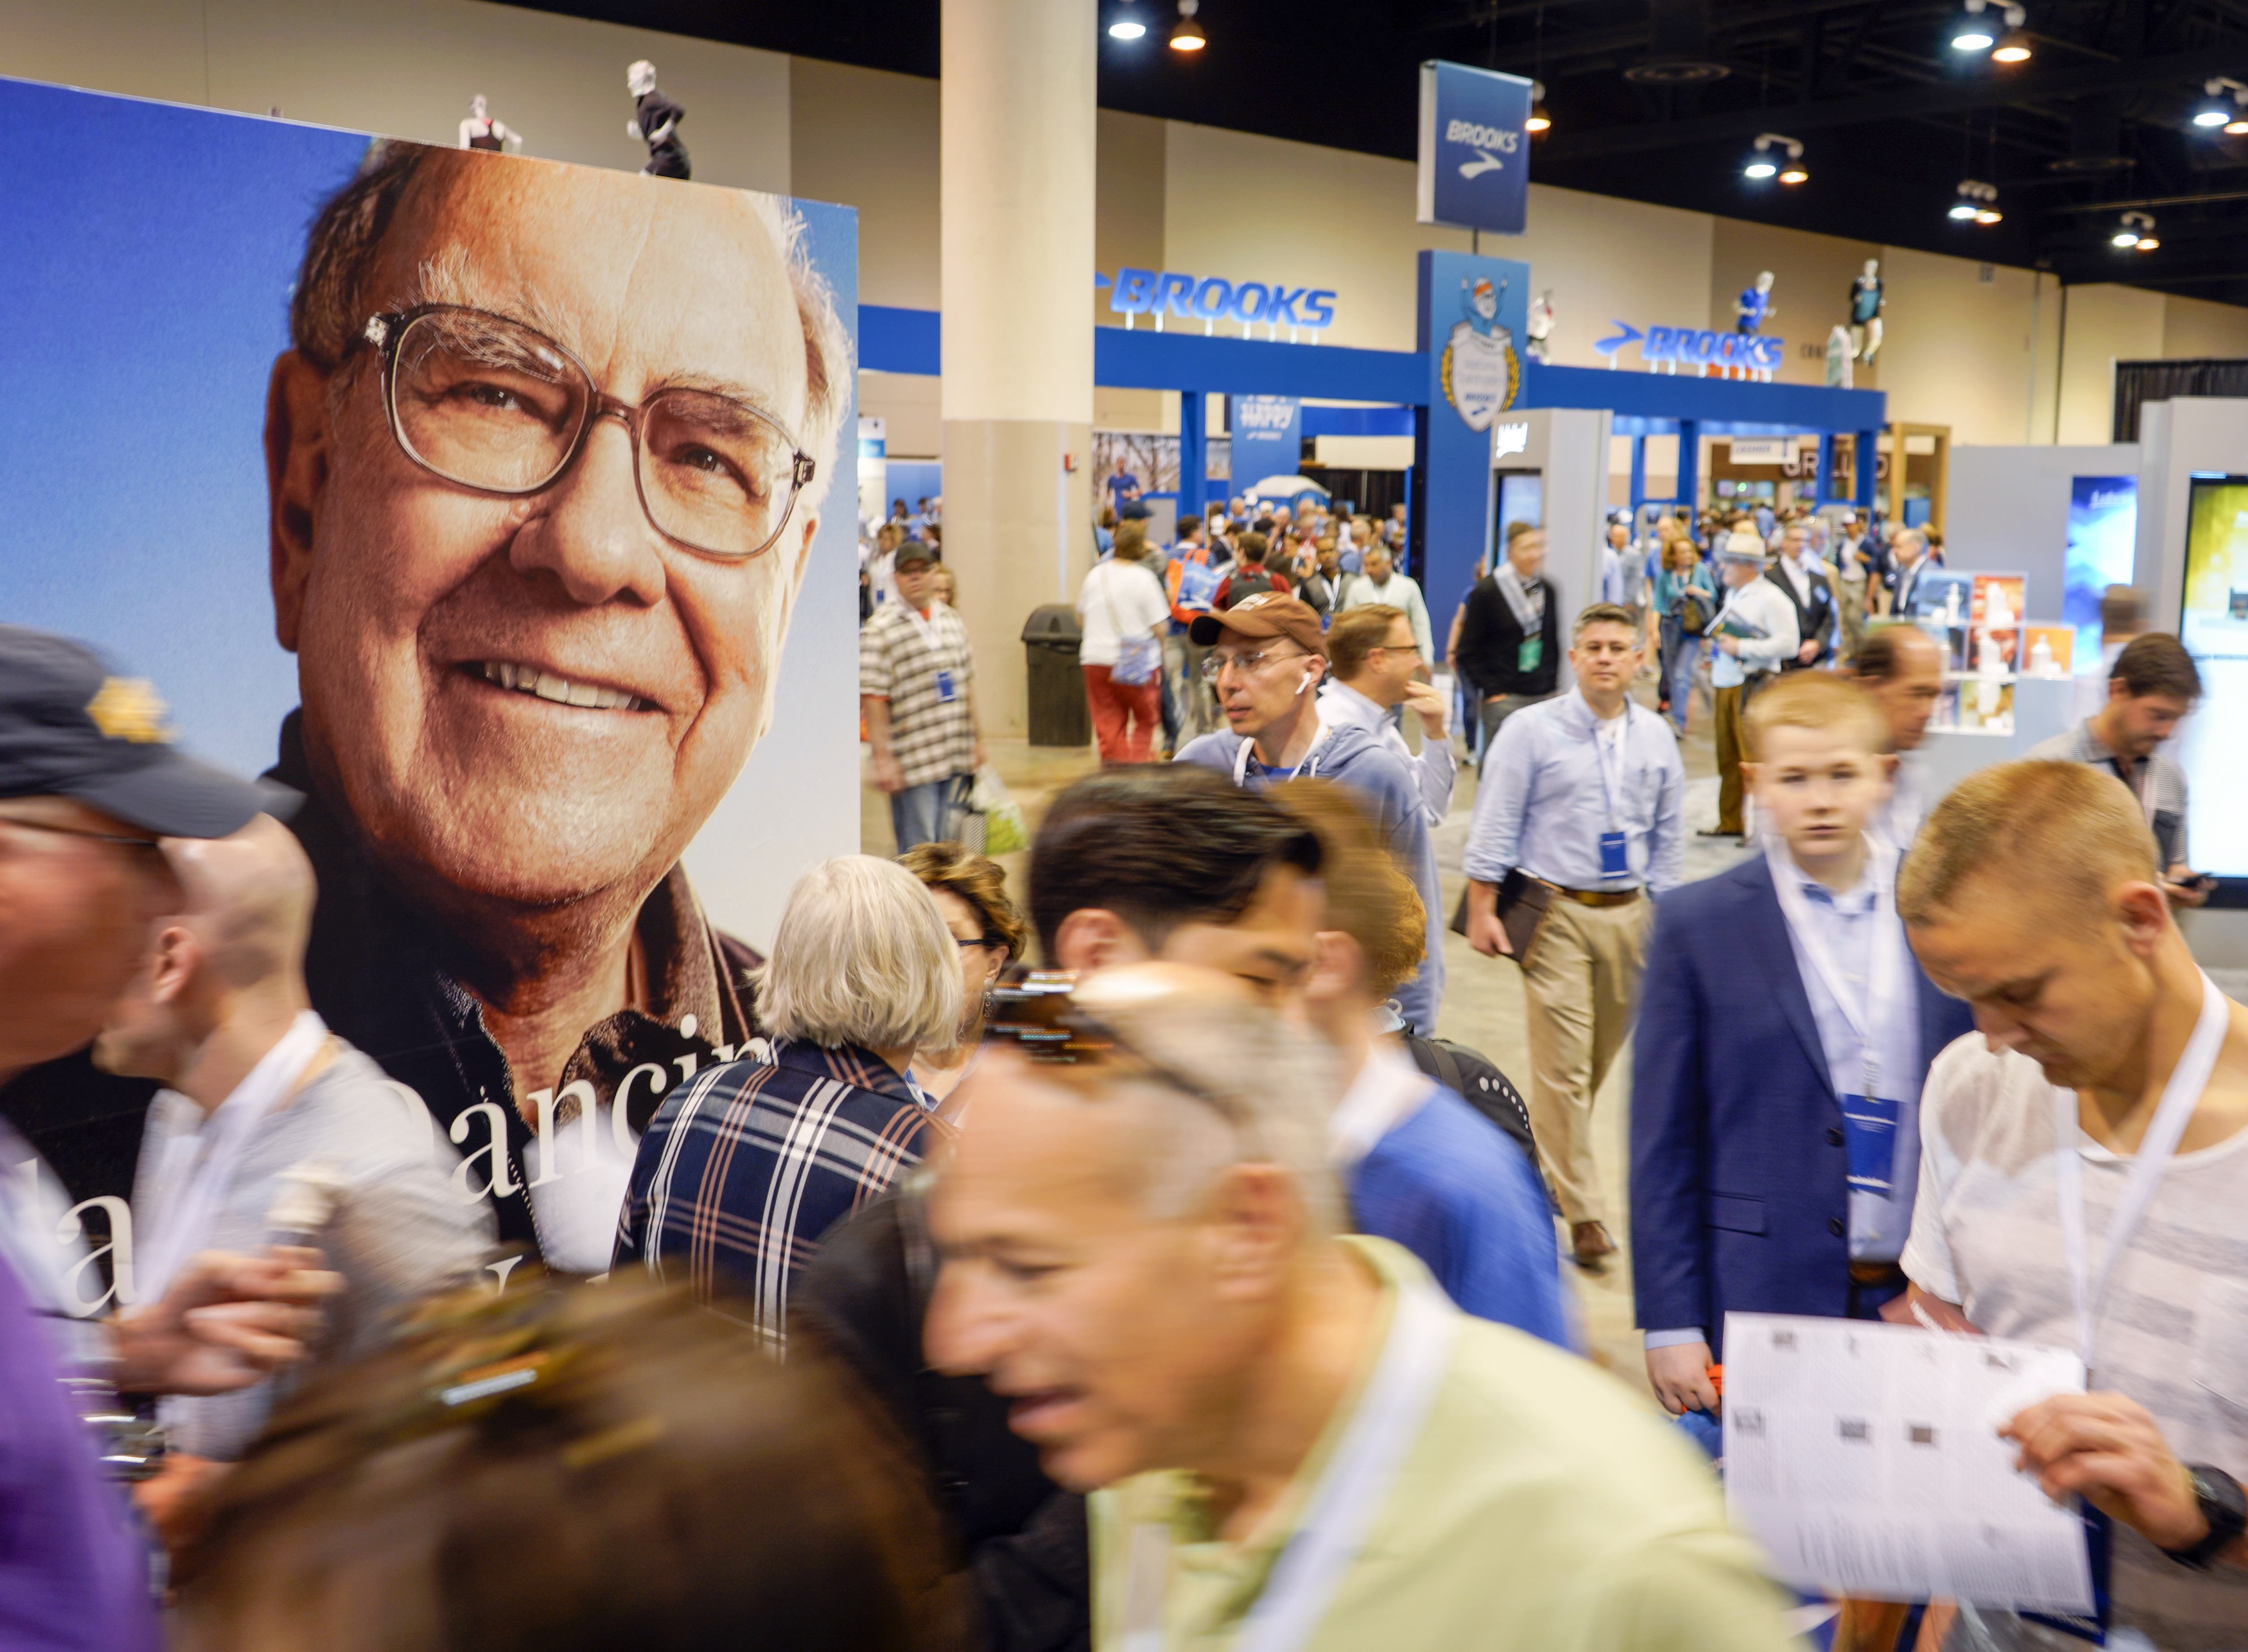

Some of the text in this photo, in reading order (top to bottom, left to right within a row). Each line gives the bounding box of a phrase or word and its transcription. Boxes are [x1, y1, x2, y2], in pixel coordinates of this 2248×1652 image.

[1446, 119, 1519, 153] BROOKS
[1110, 268, 1337, 328] BROOKS
[1641, 326, 1784, 371] BROOKS
